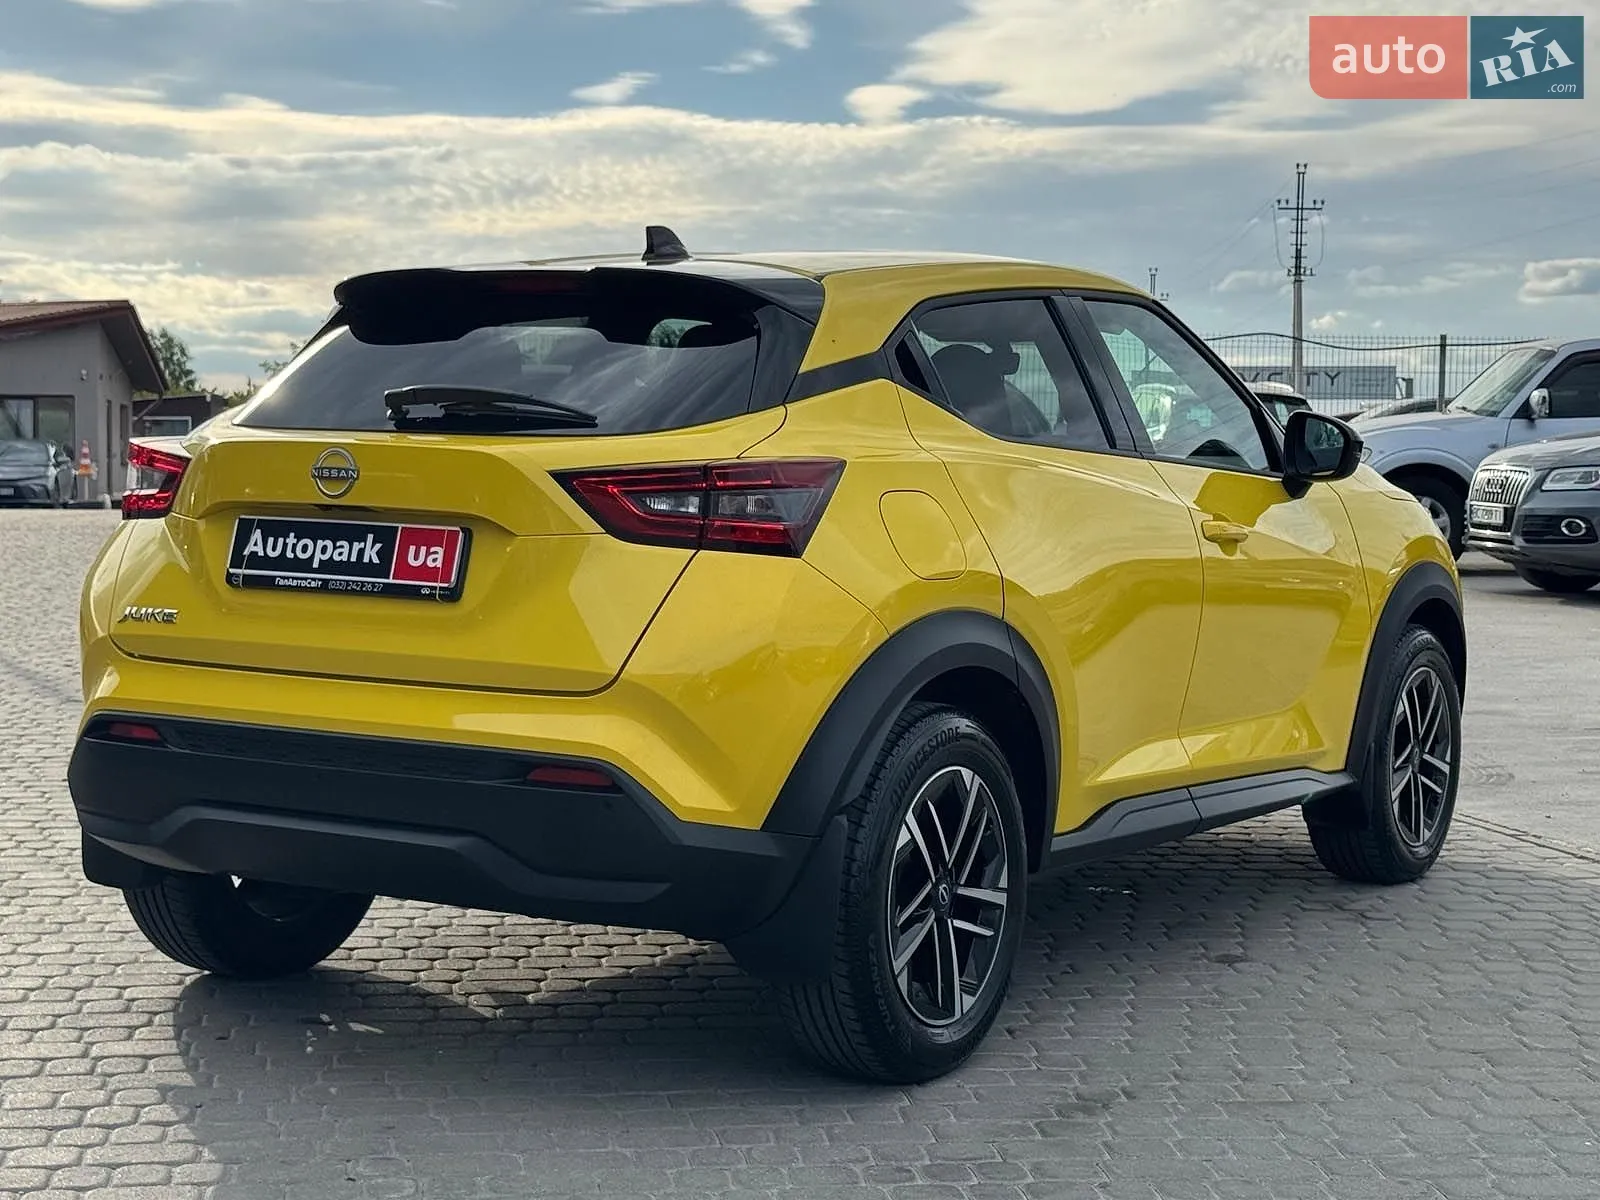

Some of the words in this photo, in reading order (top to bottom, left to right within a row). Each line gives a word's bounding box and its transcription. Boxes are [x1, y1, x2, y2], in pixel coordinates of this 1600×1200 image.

[311, 468, 358, 479] NISSAN
[243, 529, 384, 568] Autopark
[407, 544, 444, 569] ua
[328, 580, 347, 591] (032)
[348, 582, 361, 591] 242
[362, 583, 373, 592] 26
[373, 584, 384, 593] 27
[117, 606, 178, 623] JUKE
